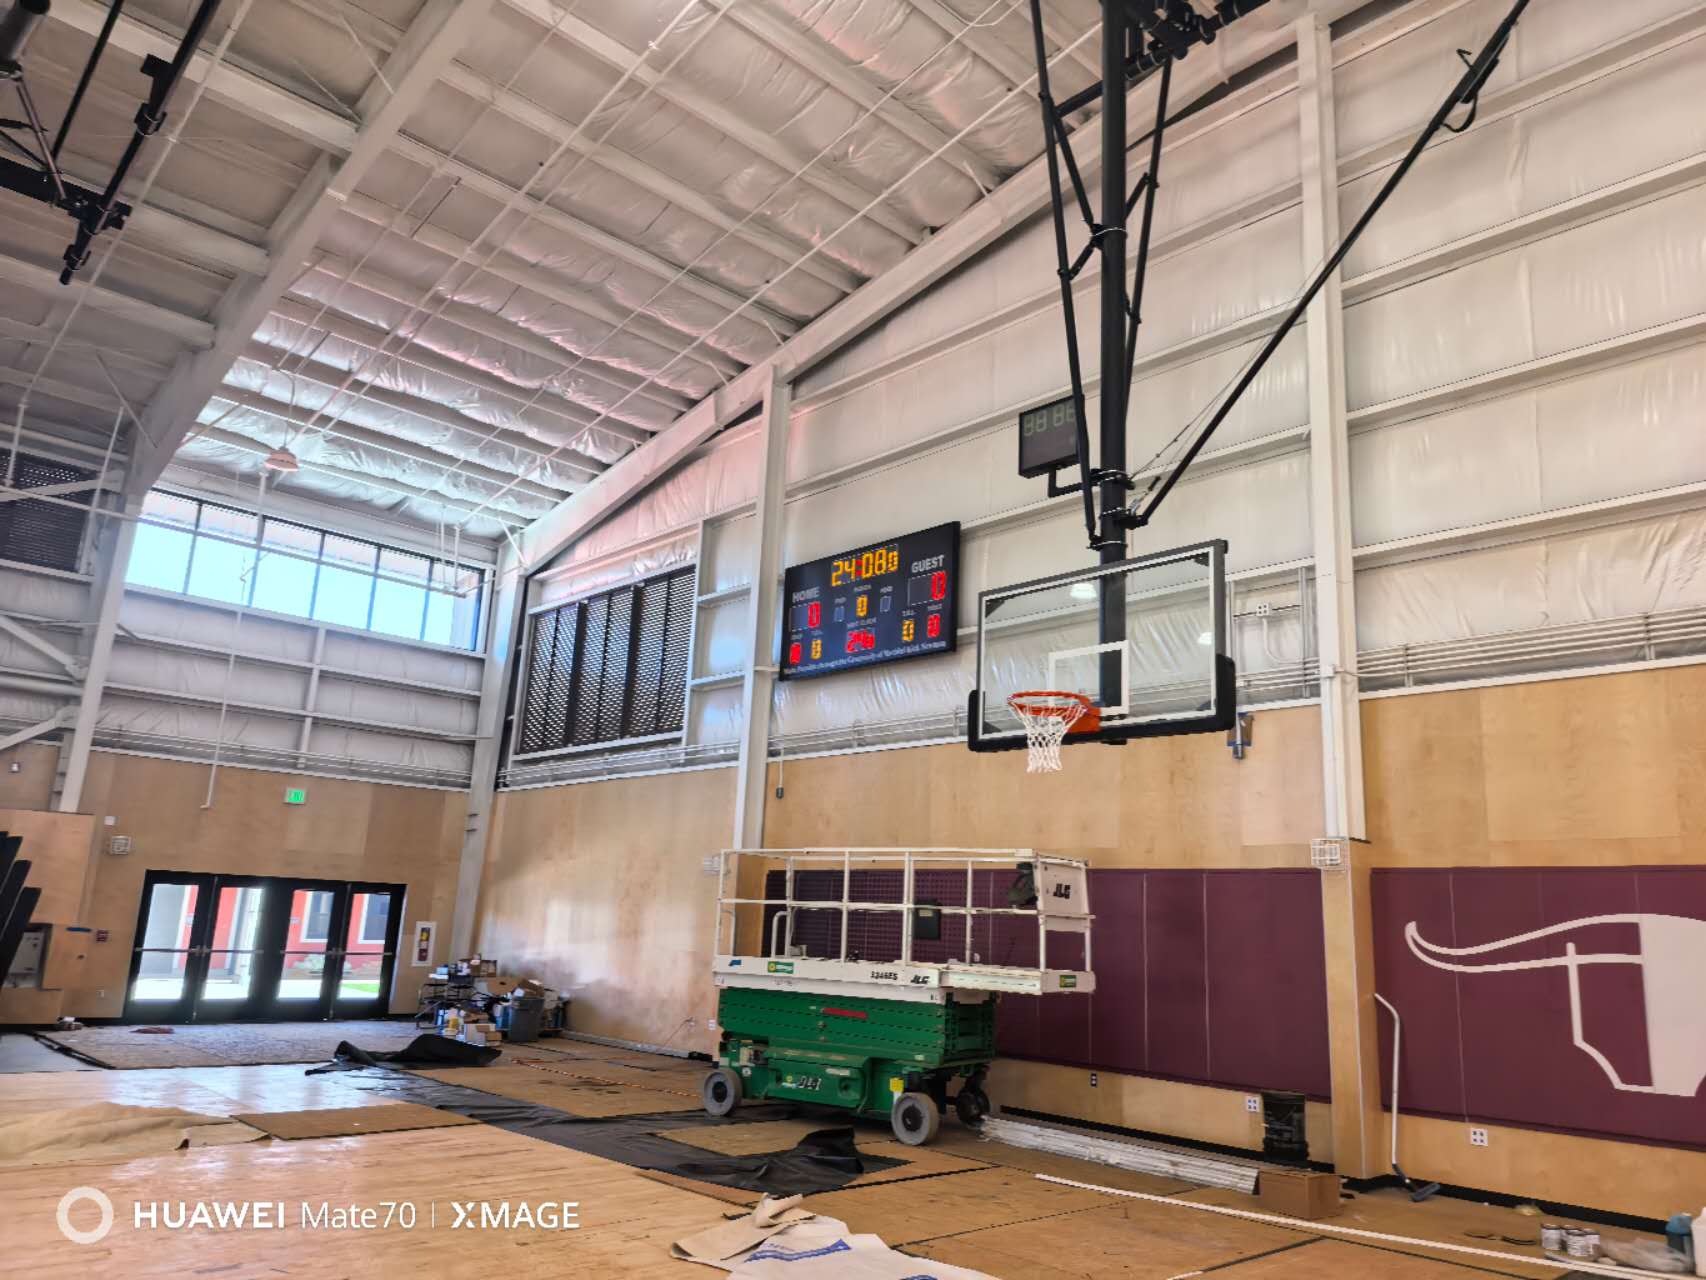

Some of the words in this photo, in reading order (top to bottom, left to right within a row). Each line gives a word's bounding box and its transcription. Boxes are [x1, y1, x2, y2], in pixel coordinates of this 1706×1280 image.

[911, 555, 945, 573] GUEST
[792, 586, 821, 603] HOME
[931, 571, 946, 601] 0
[807, 602, 820, 628] 0
[1053, 883, 1071, 900] JLG
[910, 974, 930, 985] JLG
